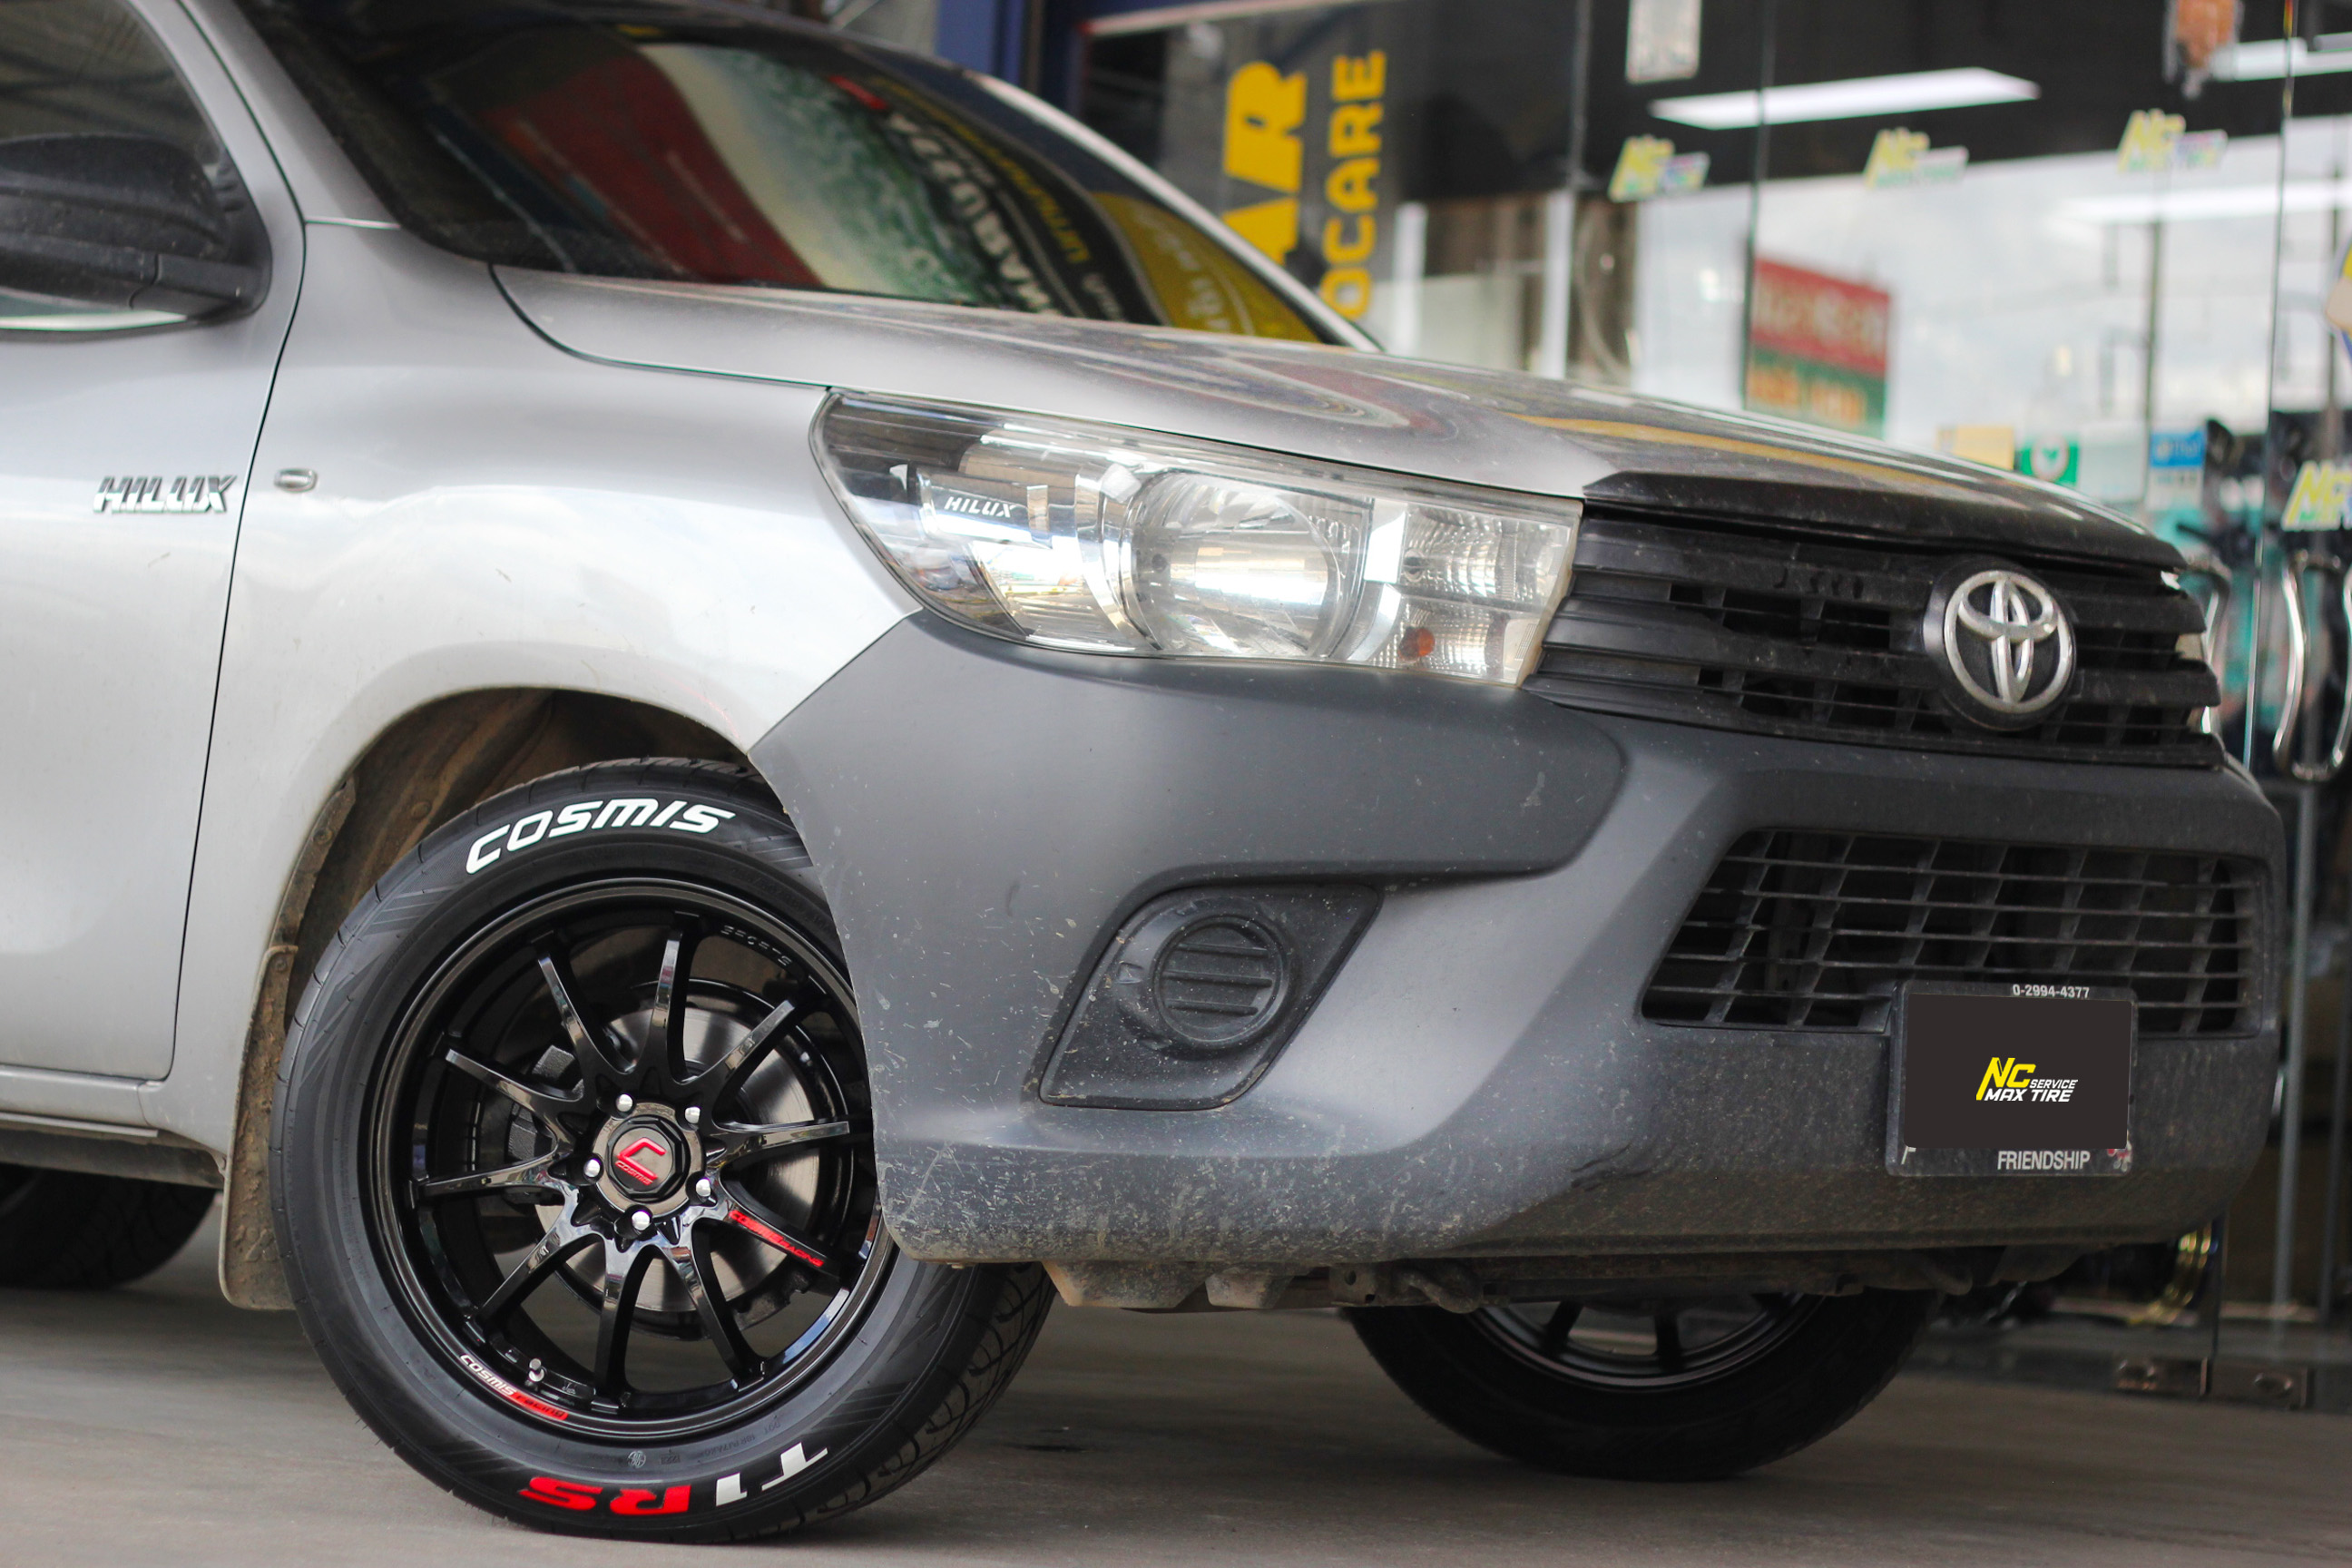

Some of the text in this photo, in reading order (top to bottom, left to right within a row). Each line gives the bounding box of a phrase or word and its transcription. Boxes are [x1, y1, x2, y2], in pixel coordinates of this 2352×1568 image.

[93, 475, 237, 514] HILUX
[945, 496, 1018, 518] HILUX
[466, 799, 736, 874] COSMIS
[2012, 984, 2091, 998] 0-2994-4377
[1997, 1150, 2091, 1171] FRIENDSHIP
[460, 1354, 518, 1396] COSMIS
